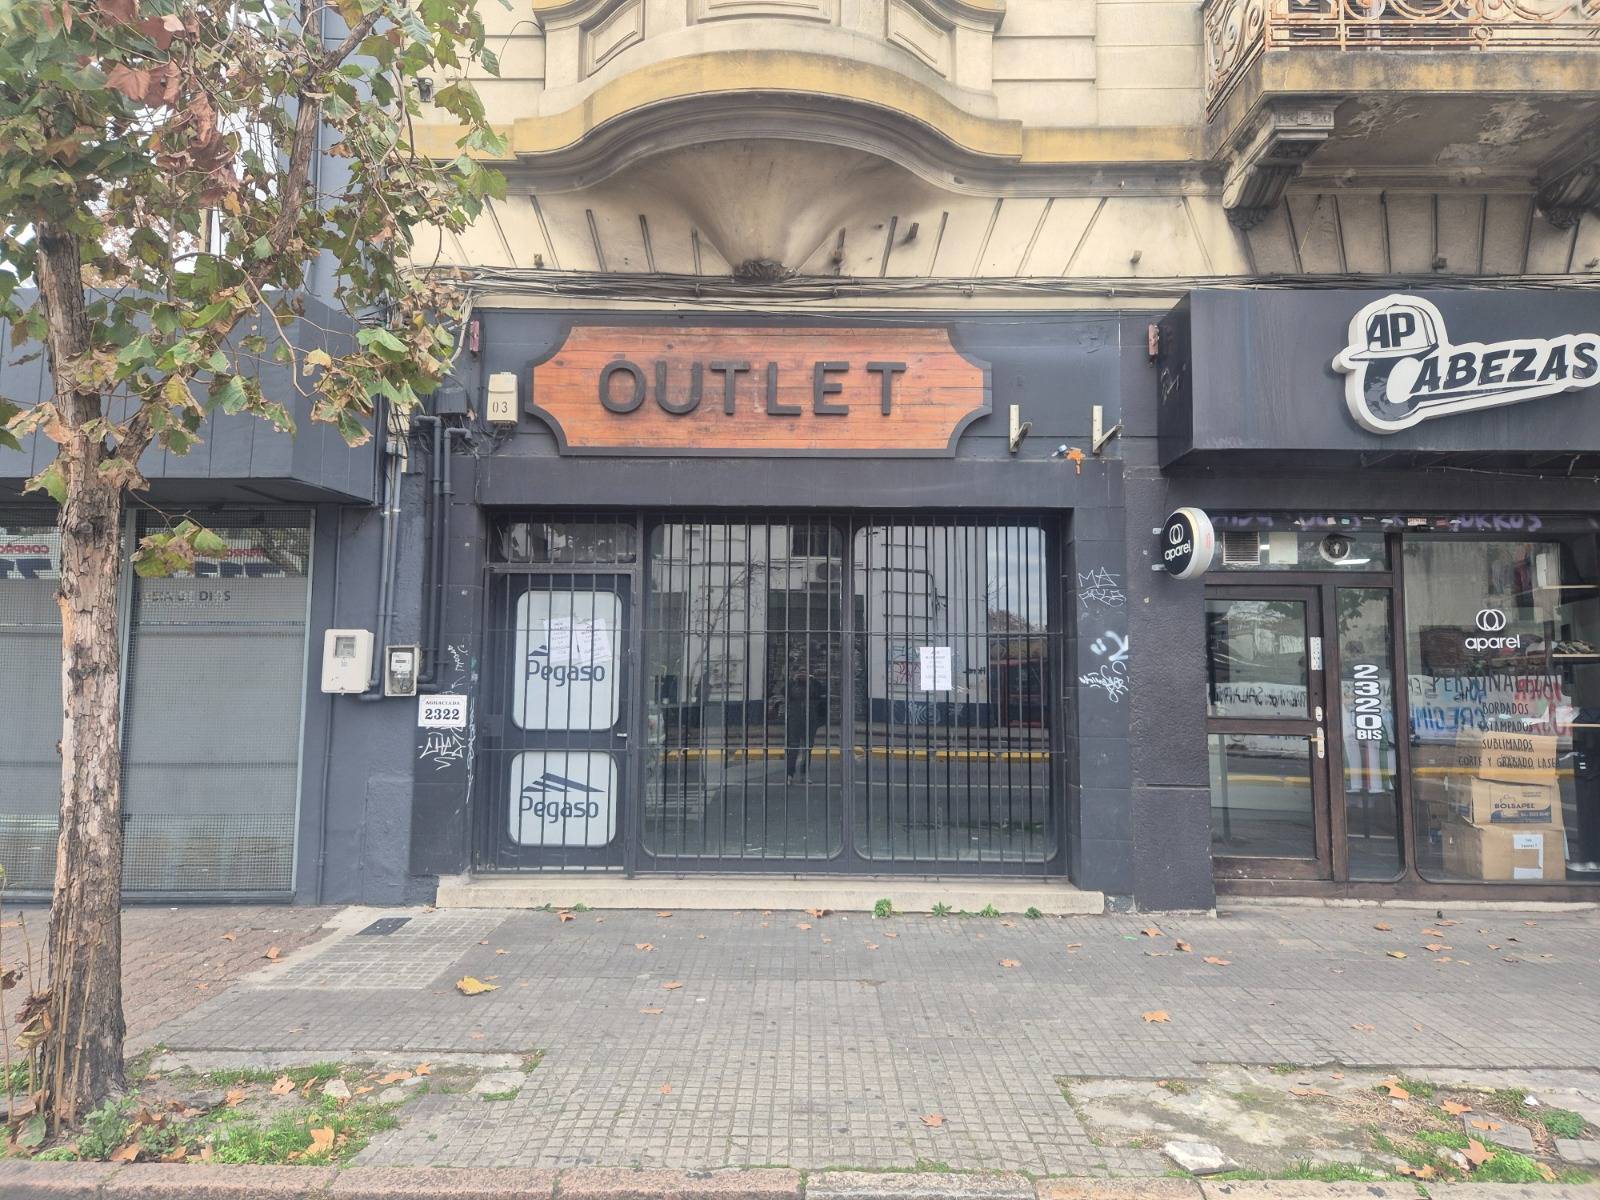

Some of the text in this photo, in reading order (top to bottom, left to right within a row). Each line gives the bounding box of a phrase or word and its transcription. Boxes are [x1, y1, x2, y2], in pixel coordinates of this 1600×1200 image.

[1367, 312, 1416, 349] AP
[598, 359, 907, 415] OUTLET
[492, 401, 509, 414] 03
[1164, 540, 1192, 562] aparel
[1464, 634, 1521, 652] aparel
[526, 659, 606, 687] Pegaso
[1353, 664, 1383, 729] 2320
[424, 708, 460, 720] 2322
[1482, 702, 1529, 714] BORDADOS
[1356, 729, 1383, 740] BIS
[1482, 739, 1534, 751] SUBLIMADOS
[1487, 757, 1492, 767] Y
[1496, 757, 1534, 768] GRABADO
[520, 795, 599, 824] Pegaso
